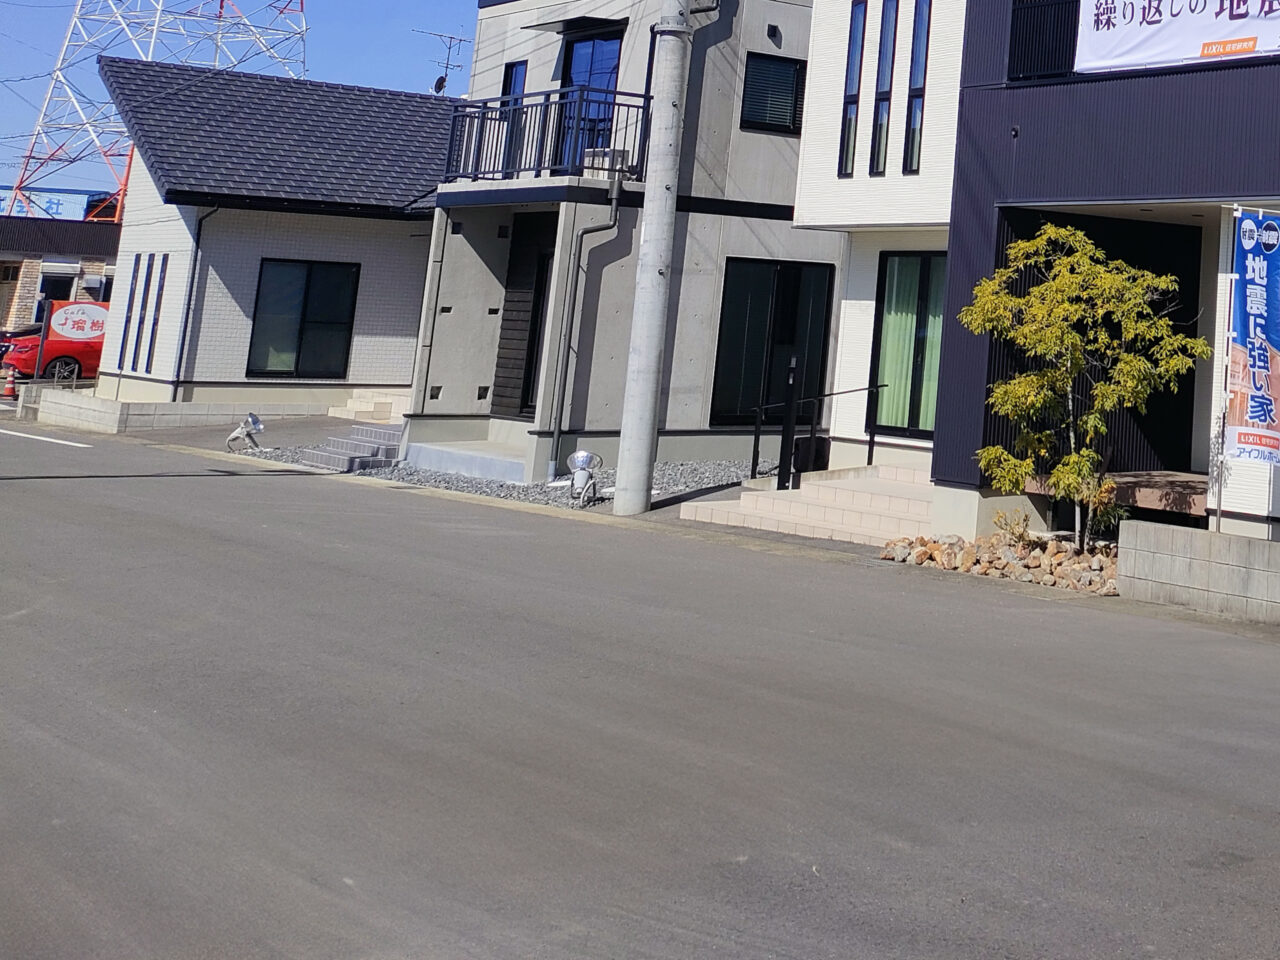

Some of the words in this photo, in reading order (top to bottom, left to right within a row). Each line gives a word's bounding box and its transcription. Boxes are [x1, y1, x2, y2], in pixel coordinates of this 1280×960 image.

[1245, 253, 1276, 425] 地震に強い家
[1241, 435, 1260, 444] LIXIL
